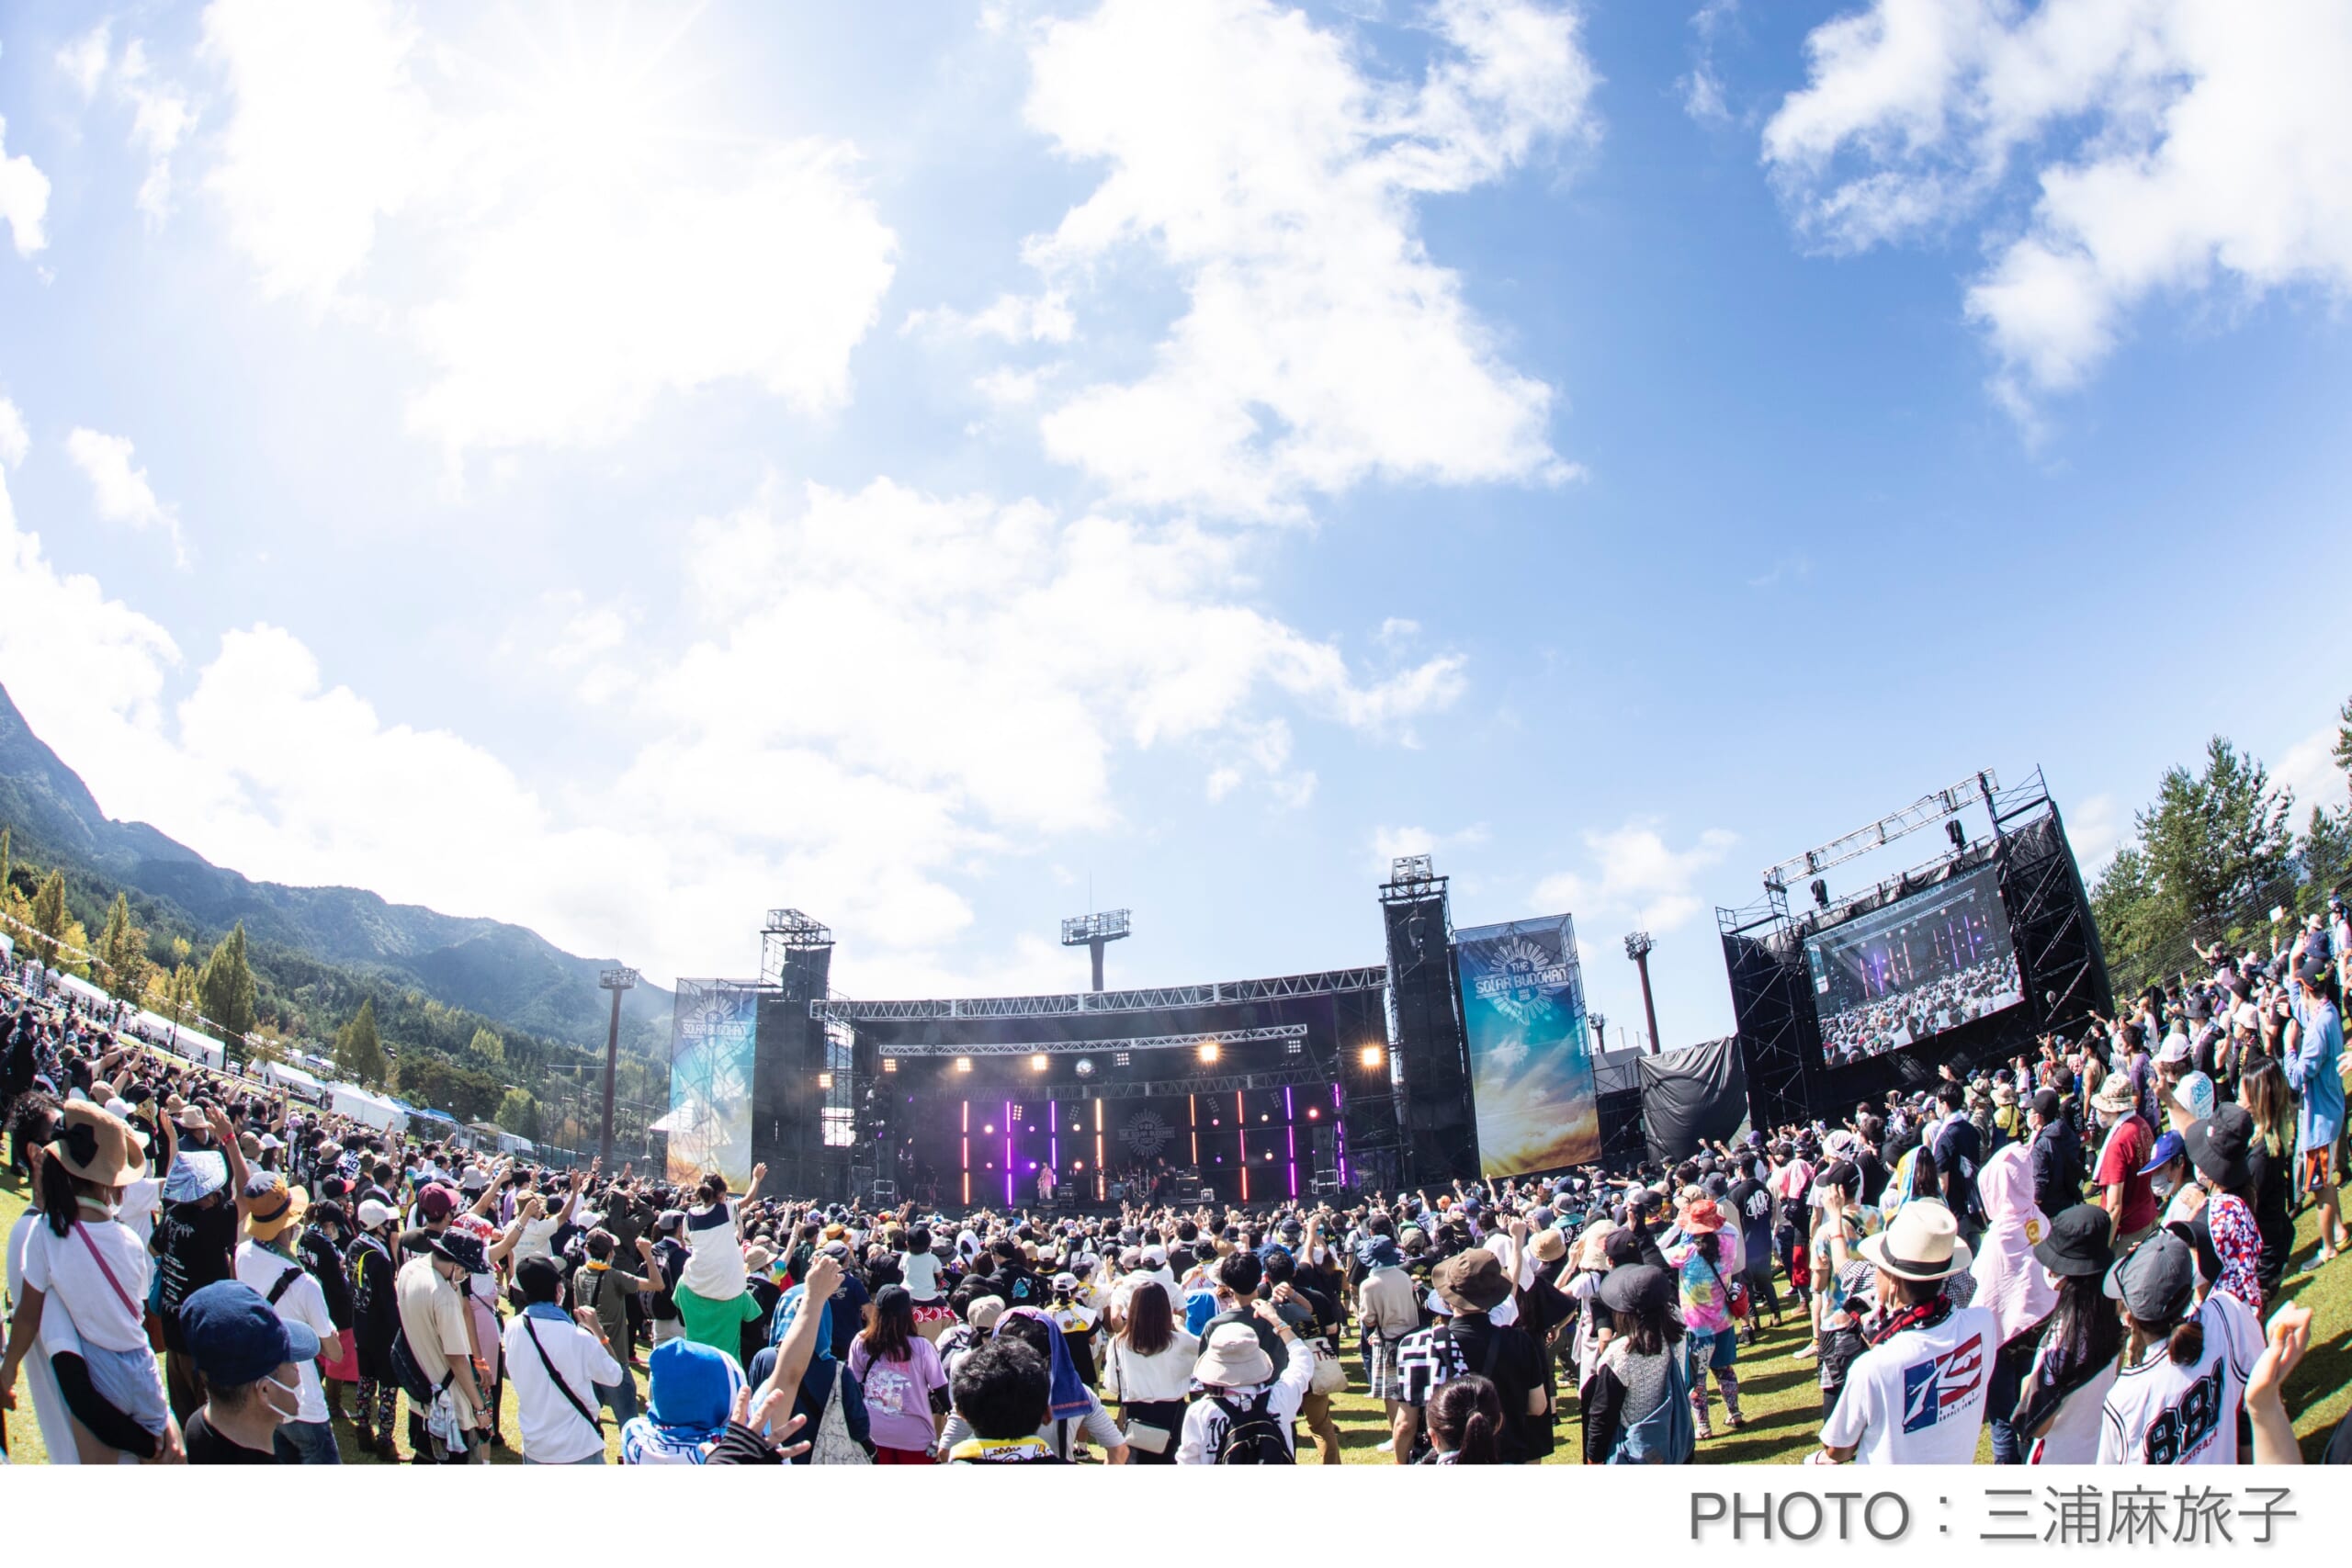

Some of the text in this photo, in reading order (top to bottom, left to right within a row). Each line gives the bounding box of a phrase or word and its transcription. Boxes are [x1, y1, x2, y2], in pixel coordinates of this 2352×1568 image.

[1510, 961, 1529, 973] THE
[1476, 969, 1566, 994] SOLAR BUDOKAN
